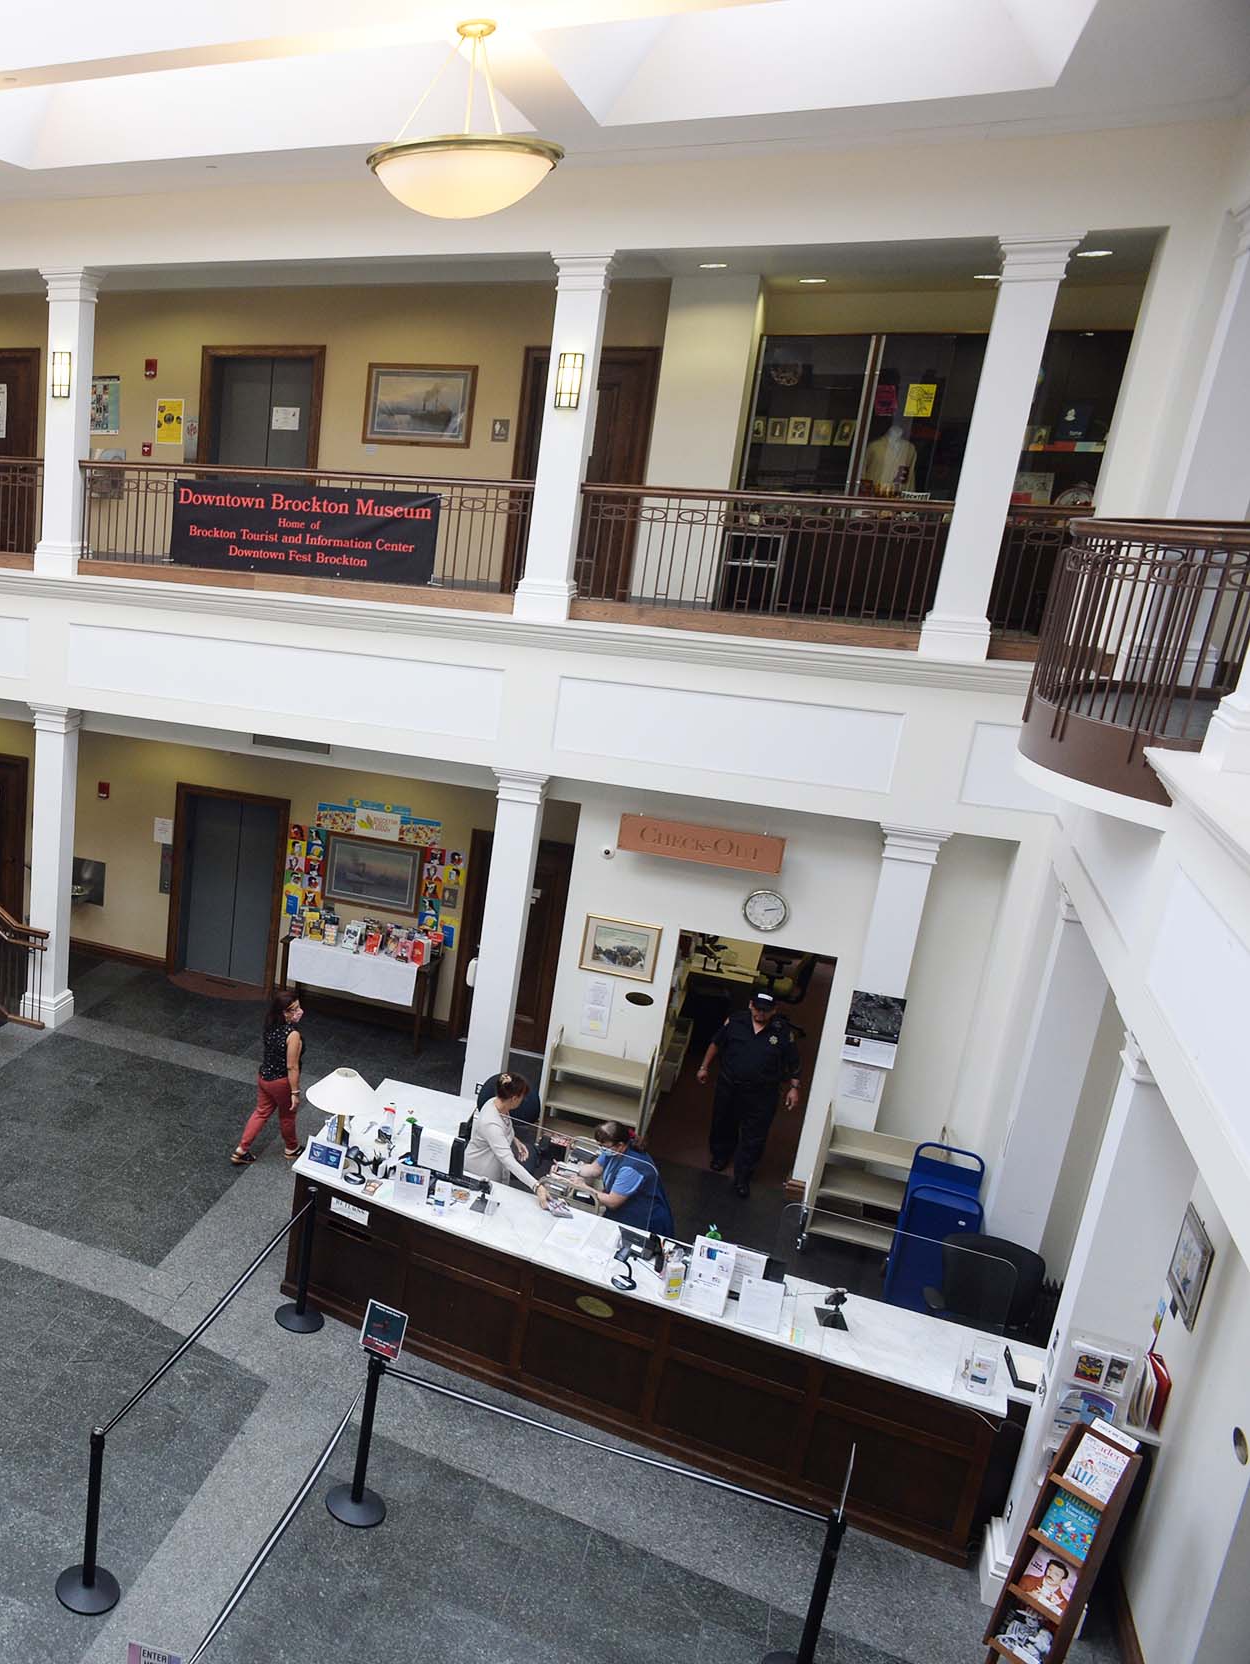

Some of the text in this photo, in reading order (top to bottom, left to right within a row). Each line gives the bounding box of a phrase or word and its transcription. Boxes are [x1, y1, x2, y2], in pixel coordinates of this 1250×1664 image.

[179, 488, 431, 520] Downtown Brockton Museum
[278, 517, 321, 530] Home of
[189, 525, 415, 553] Brockton Tourist and Information Center
[228, 545, 367, 567] Downtown Fest Brockton
[142, 1649, 167, 1664] ENTER
